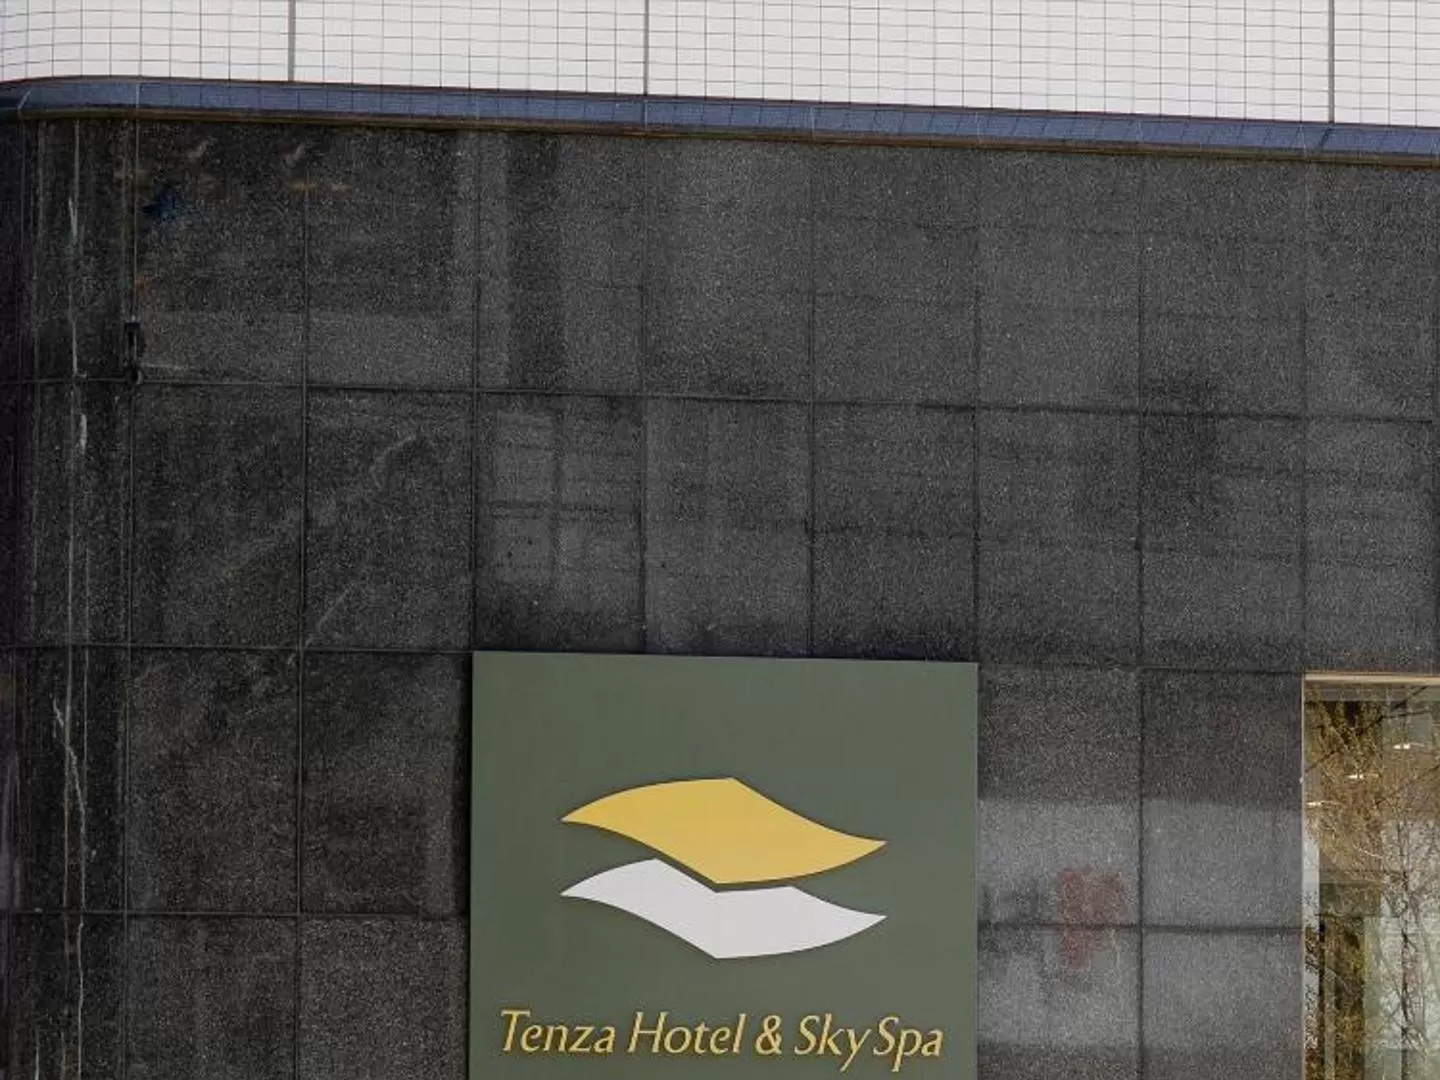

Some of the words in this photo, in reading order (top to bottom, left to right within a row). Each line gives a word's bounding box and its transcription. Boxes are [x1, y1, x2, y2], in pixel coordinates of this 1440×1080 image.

[501, 1009, 616, 1054] Tenza
[627, 1011, 747, 1055] Hotel
[754, 1014, 783, 1055] &
